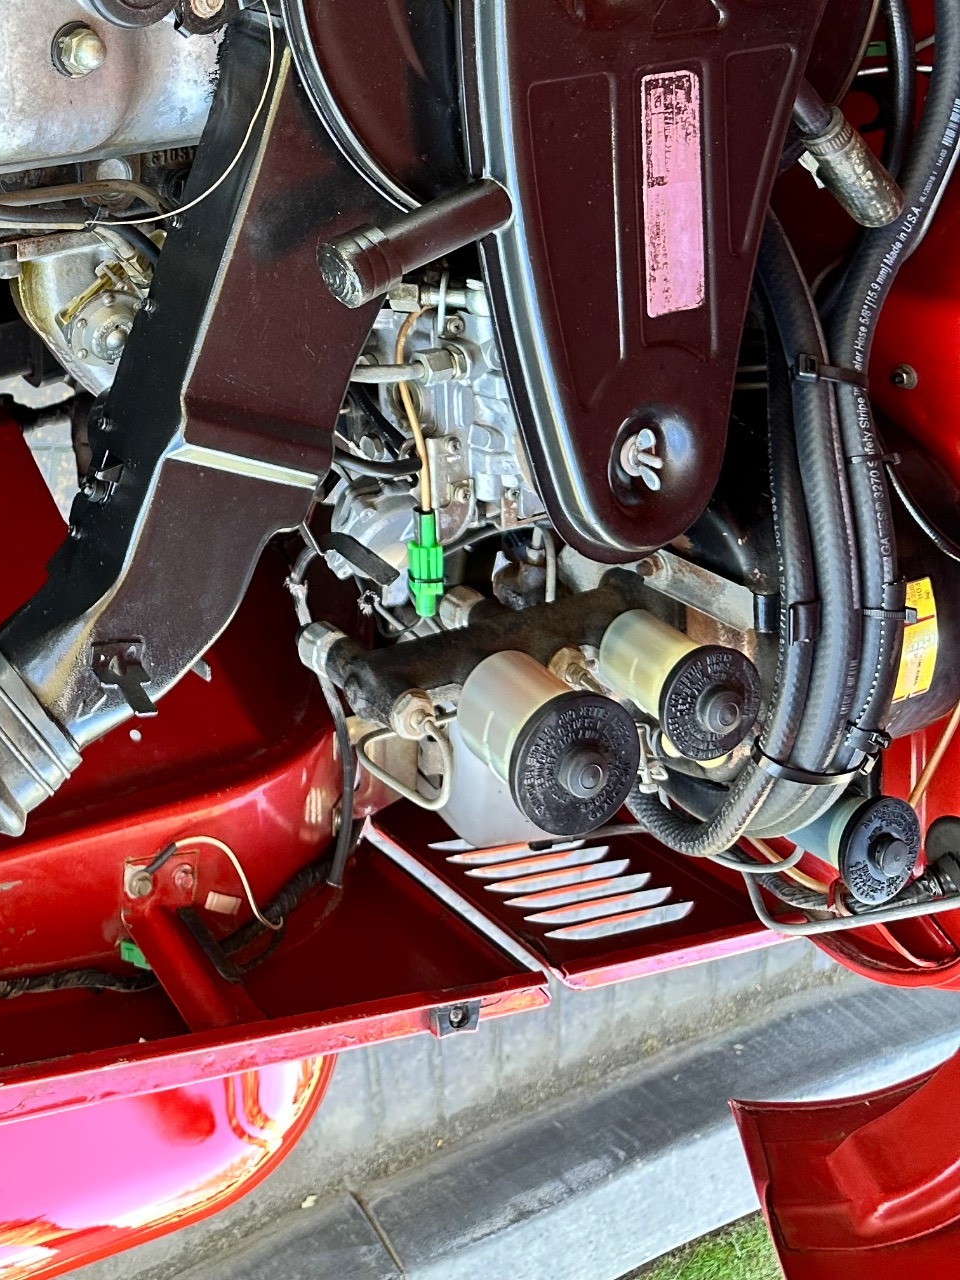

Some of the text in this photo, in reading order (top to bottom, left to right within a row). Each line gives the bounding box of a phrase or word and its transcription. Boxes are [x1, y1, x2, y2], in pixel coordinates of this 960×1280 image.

[901, 206, 924, 233] U.S.A.
[896, 231, 908, 242] in
[883, 240, 903, 267] Made
[875, 261, 892, 285] mm]
[853, 325, 869, 352] Hose
[852, 350, 864, 372] ater
[861, 429, 878, 467] Sfety
[869, 469, 885, 499] 3270
